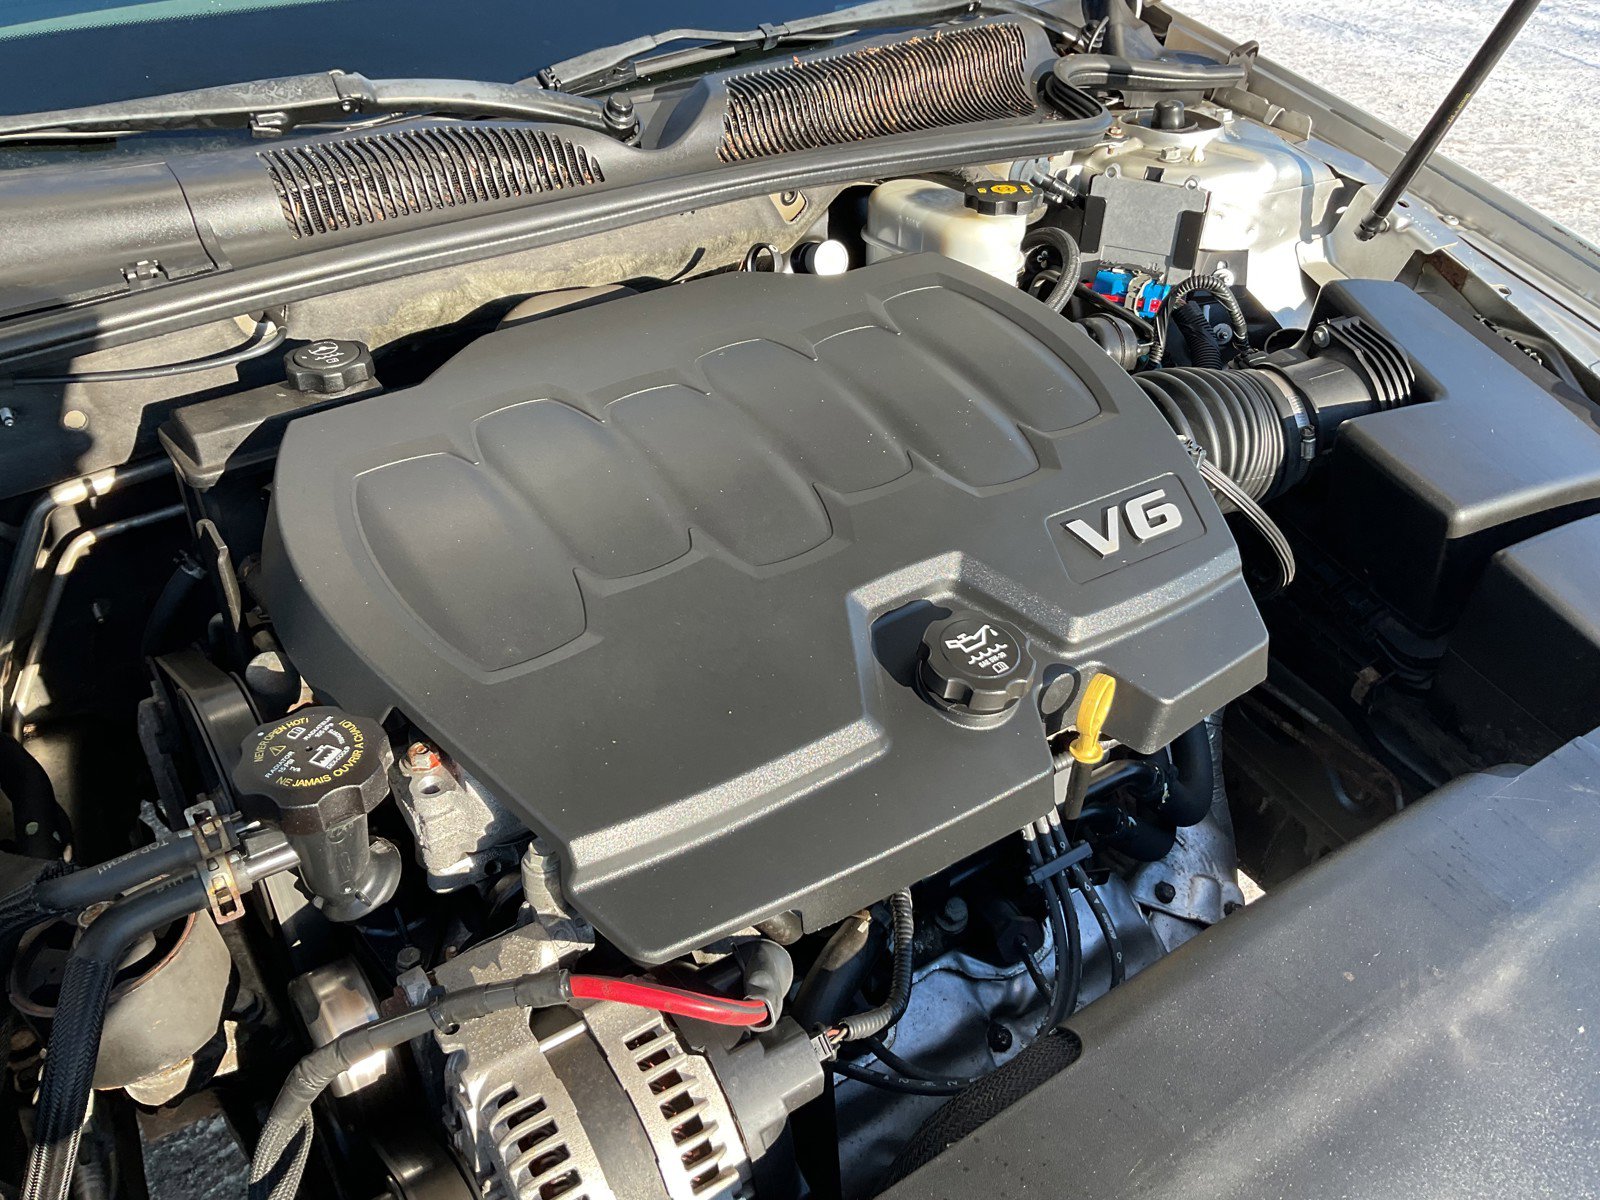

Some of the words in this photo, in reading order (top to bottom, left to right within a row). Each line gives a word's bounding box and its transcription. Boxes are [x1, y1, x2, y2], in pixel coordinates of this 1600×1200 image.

[1065, 489, 1182, 556] V6
[266, 725, 288, 742] OPEN
[286, 717, 309, 729] HOT!
[264, 750, 295, 779] RADIATOR
[276, 776, 293, 787] NE
[292, 774, 332, 787] JAMAIS
[333, 749, 364, 777] OUVRIR
